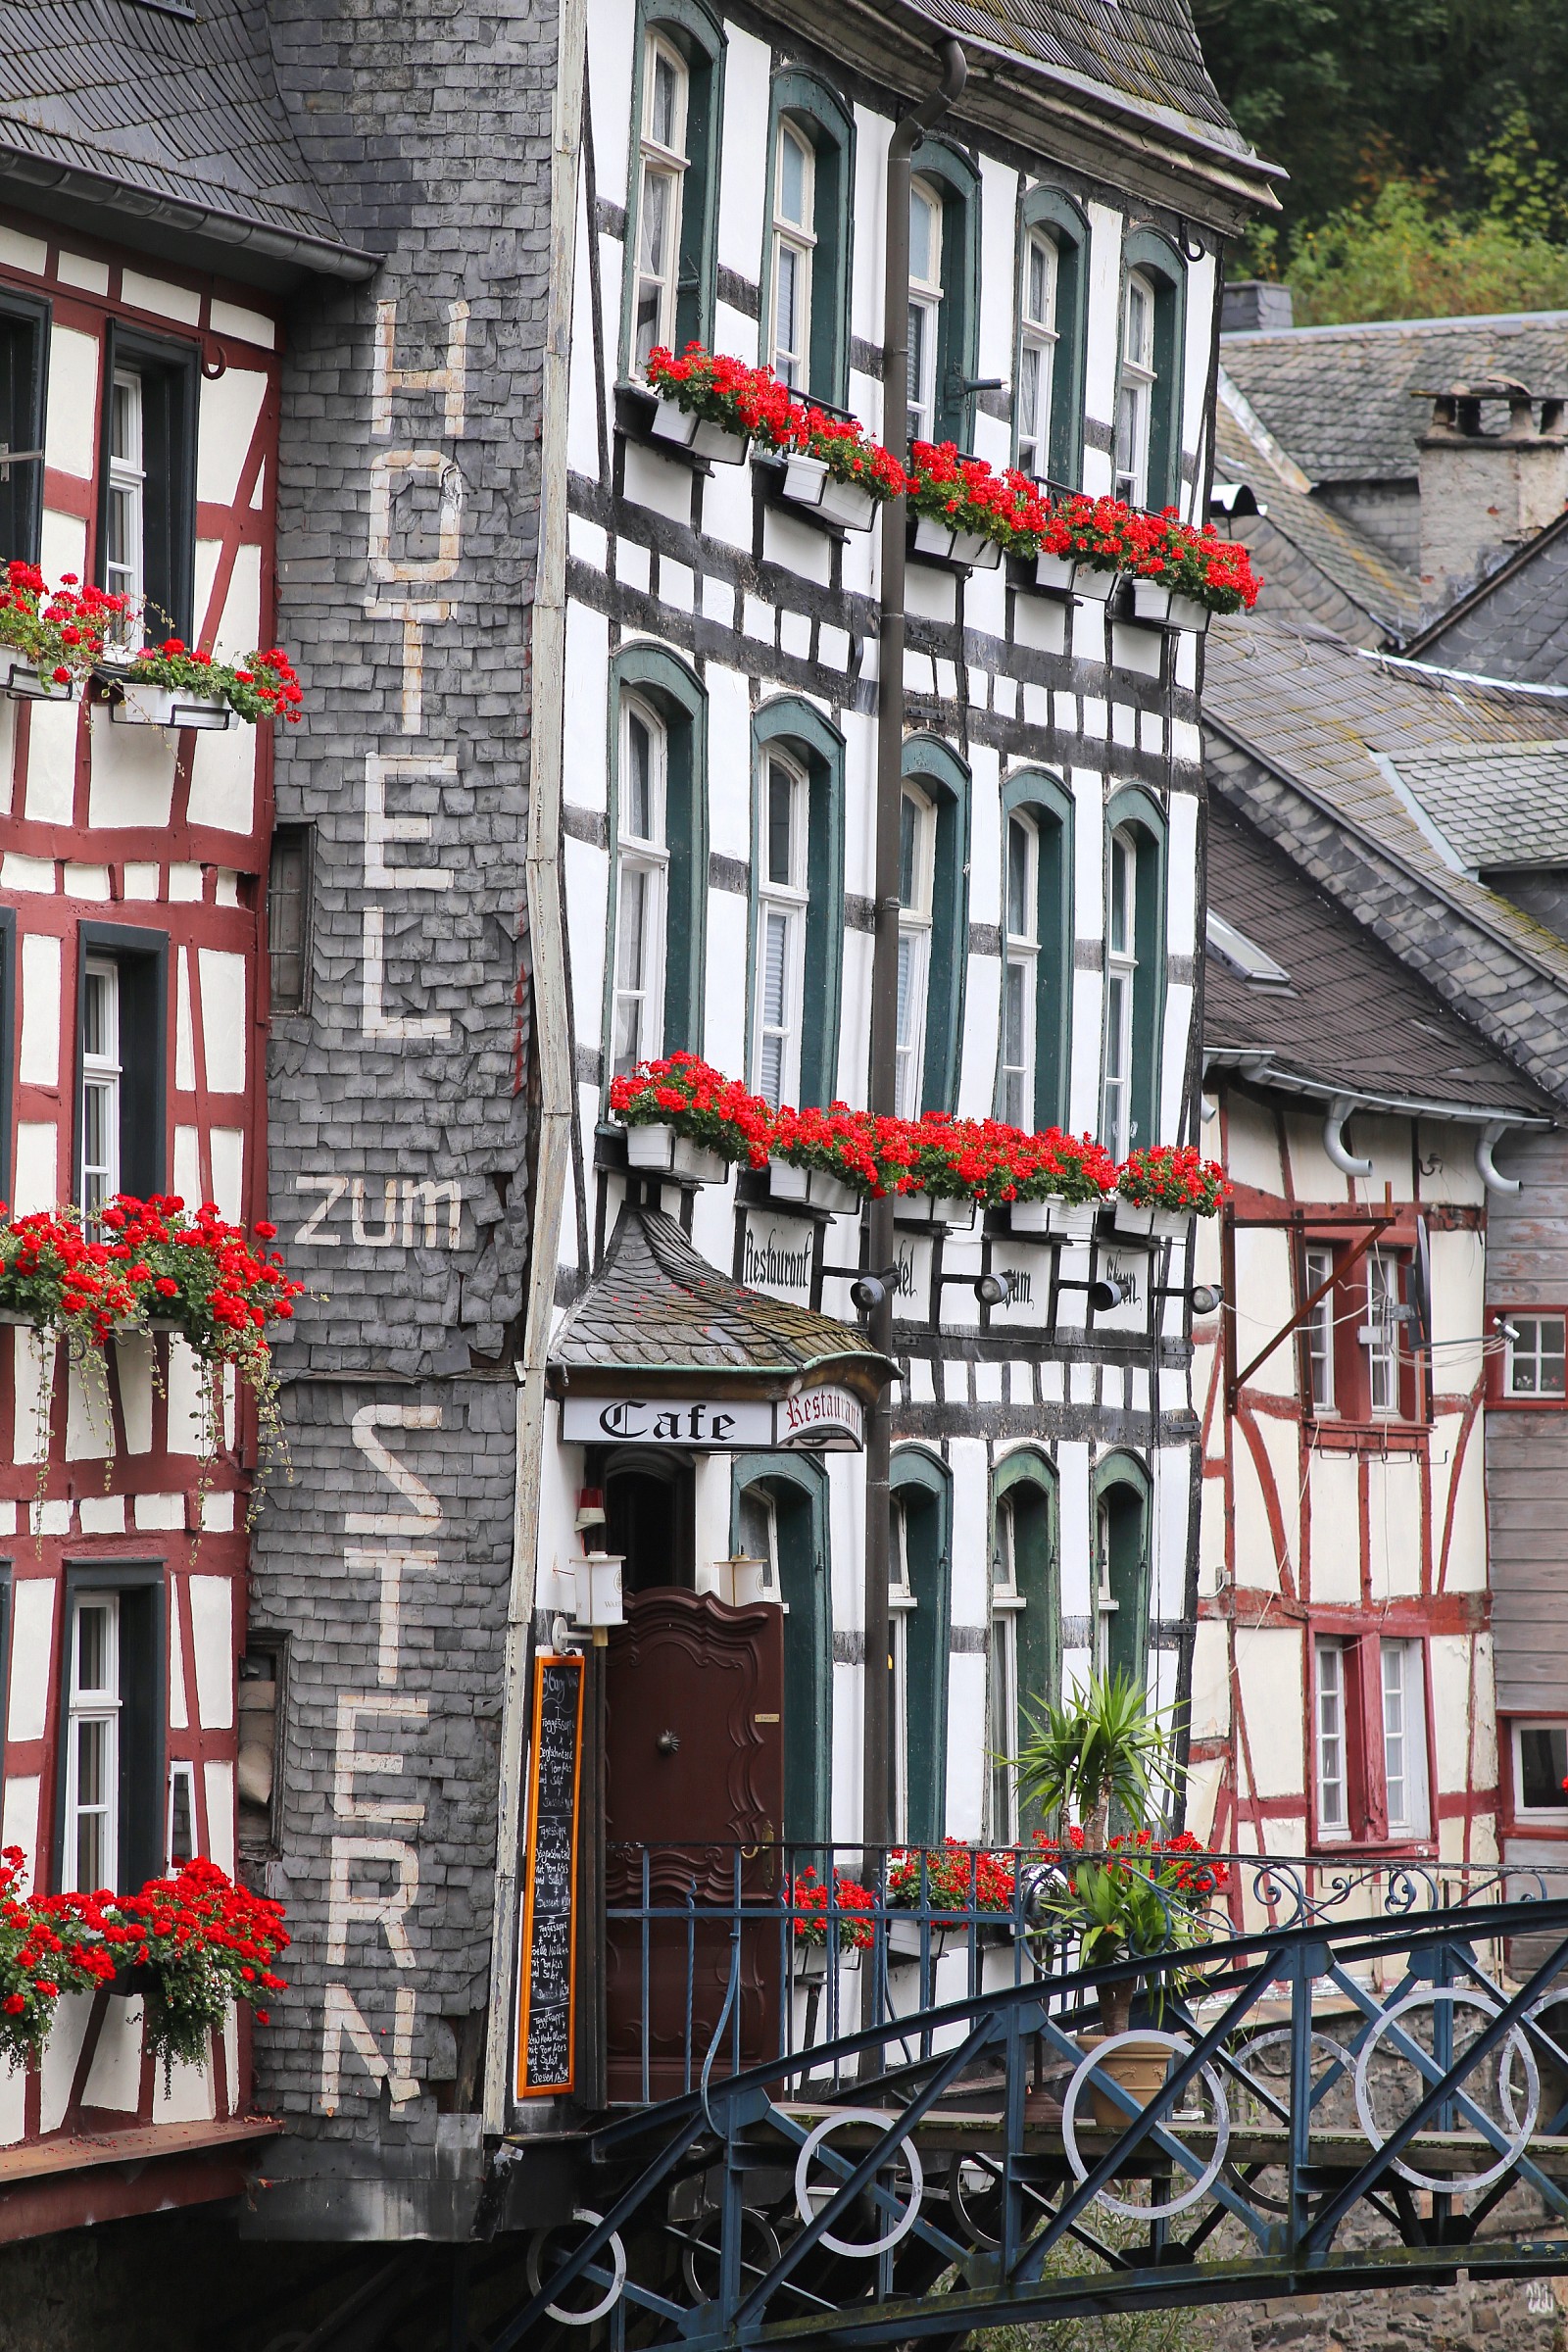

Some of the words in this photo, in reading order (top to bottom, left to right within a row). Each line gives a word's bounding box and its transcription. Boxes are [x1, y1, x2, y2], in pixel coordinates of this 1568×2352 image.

[363, 298, 470, 1039] HOTEL
[744, 1228, 813, 1292] Restaurant
[892, 1239, 917, 1299] tel
[599, 1399, 736, 1442] Cafe
[786, 1389, 859, 1435] Restaurant
[320, 1404, 444, 2118] STERN
